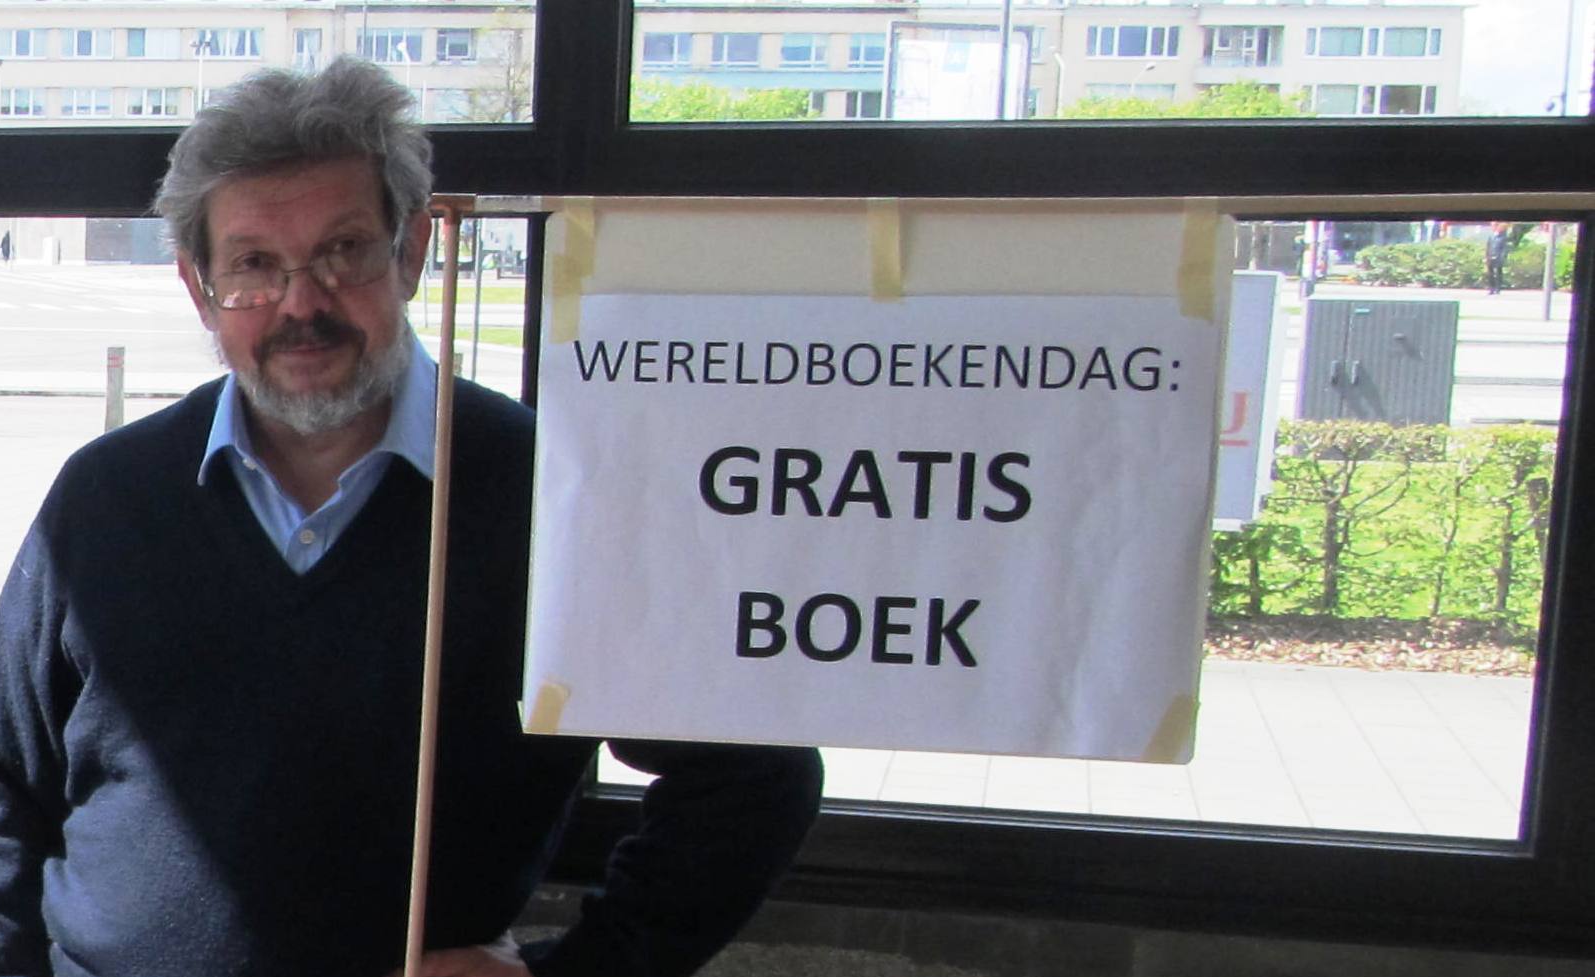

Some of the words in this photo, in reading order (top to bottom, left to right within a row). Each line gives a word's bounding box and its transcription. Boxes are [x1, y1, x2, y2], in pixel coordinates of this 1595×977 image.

[573, 339, 1183, 393] WERELDBOEKENDAG:
[698, 445, 1034, 524] GRATIS
[734, 591, 983, 668] BOEK
